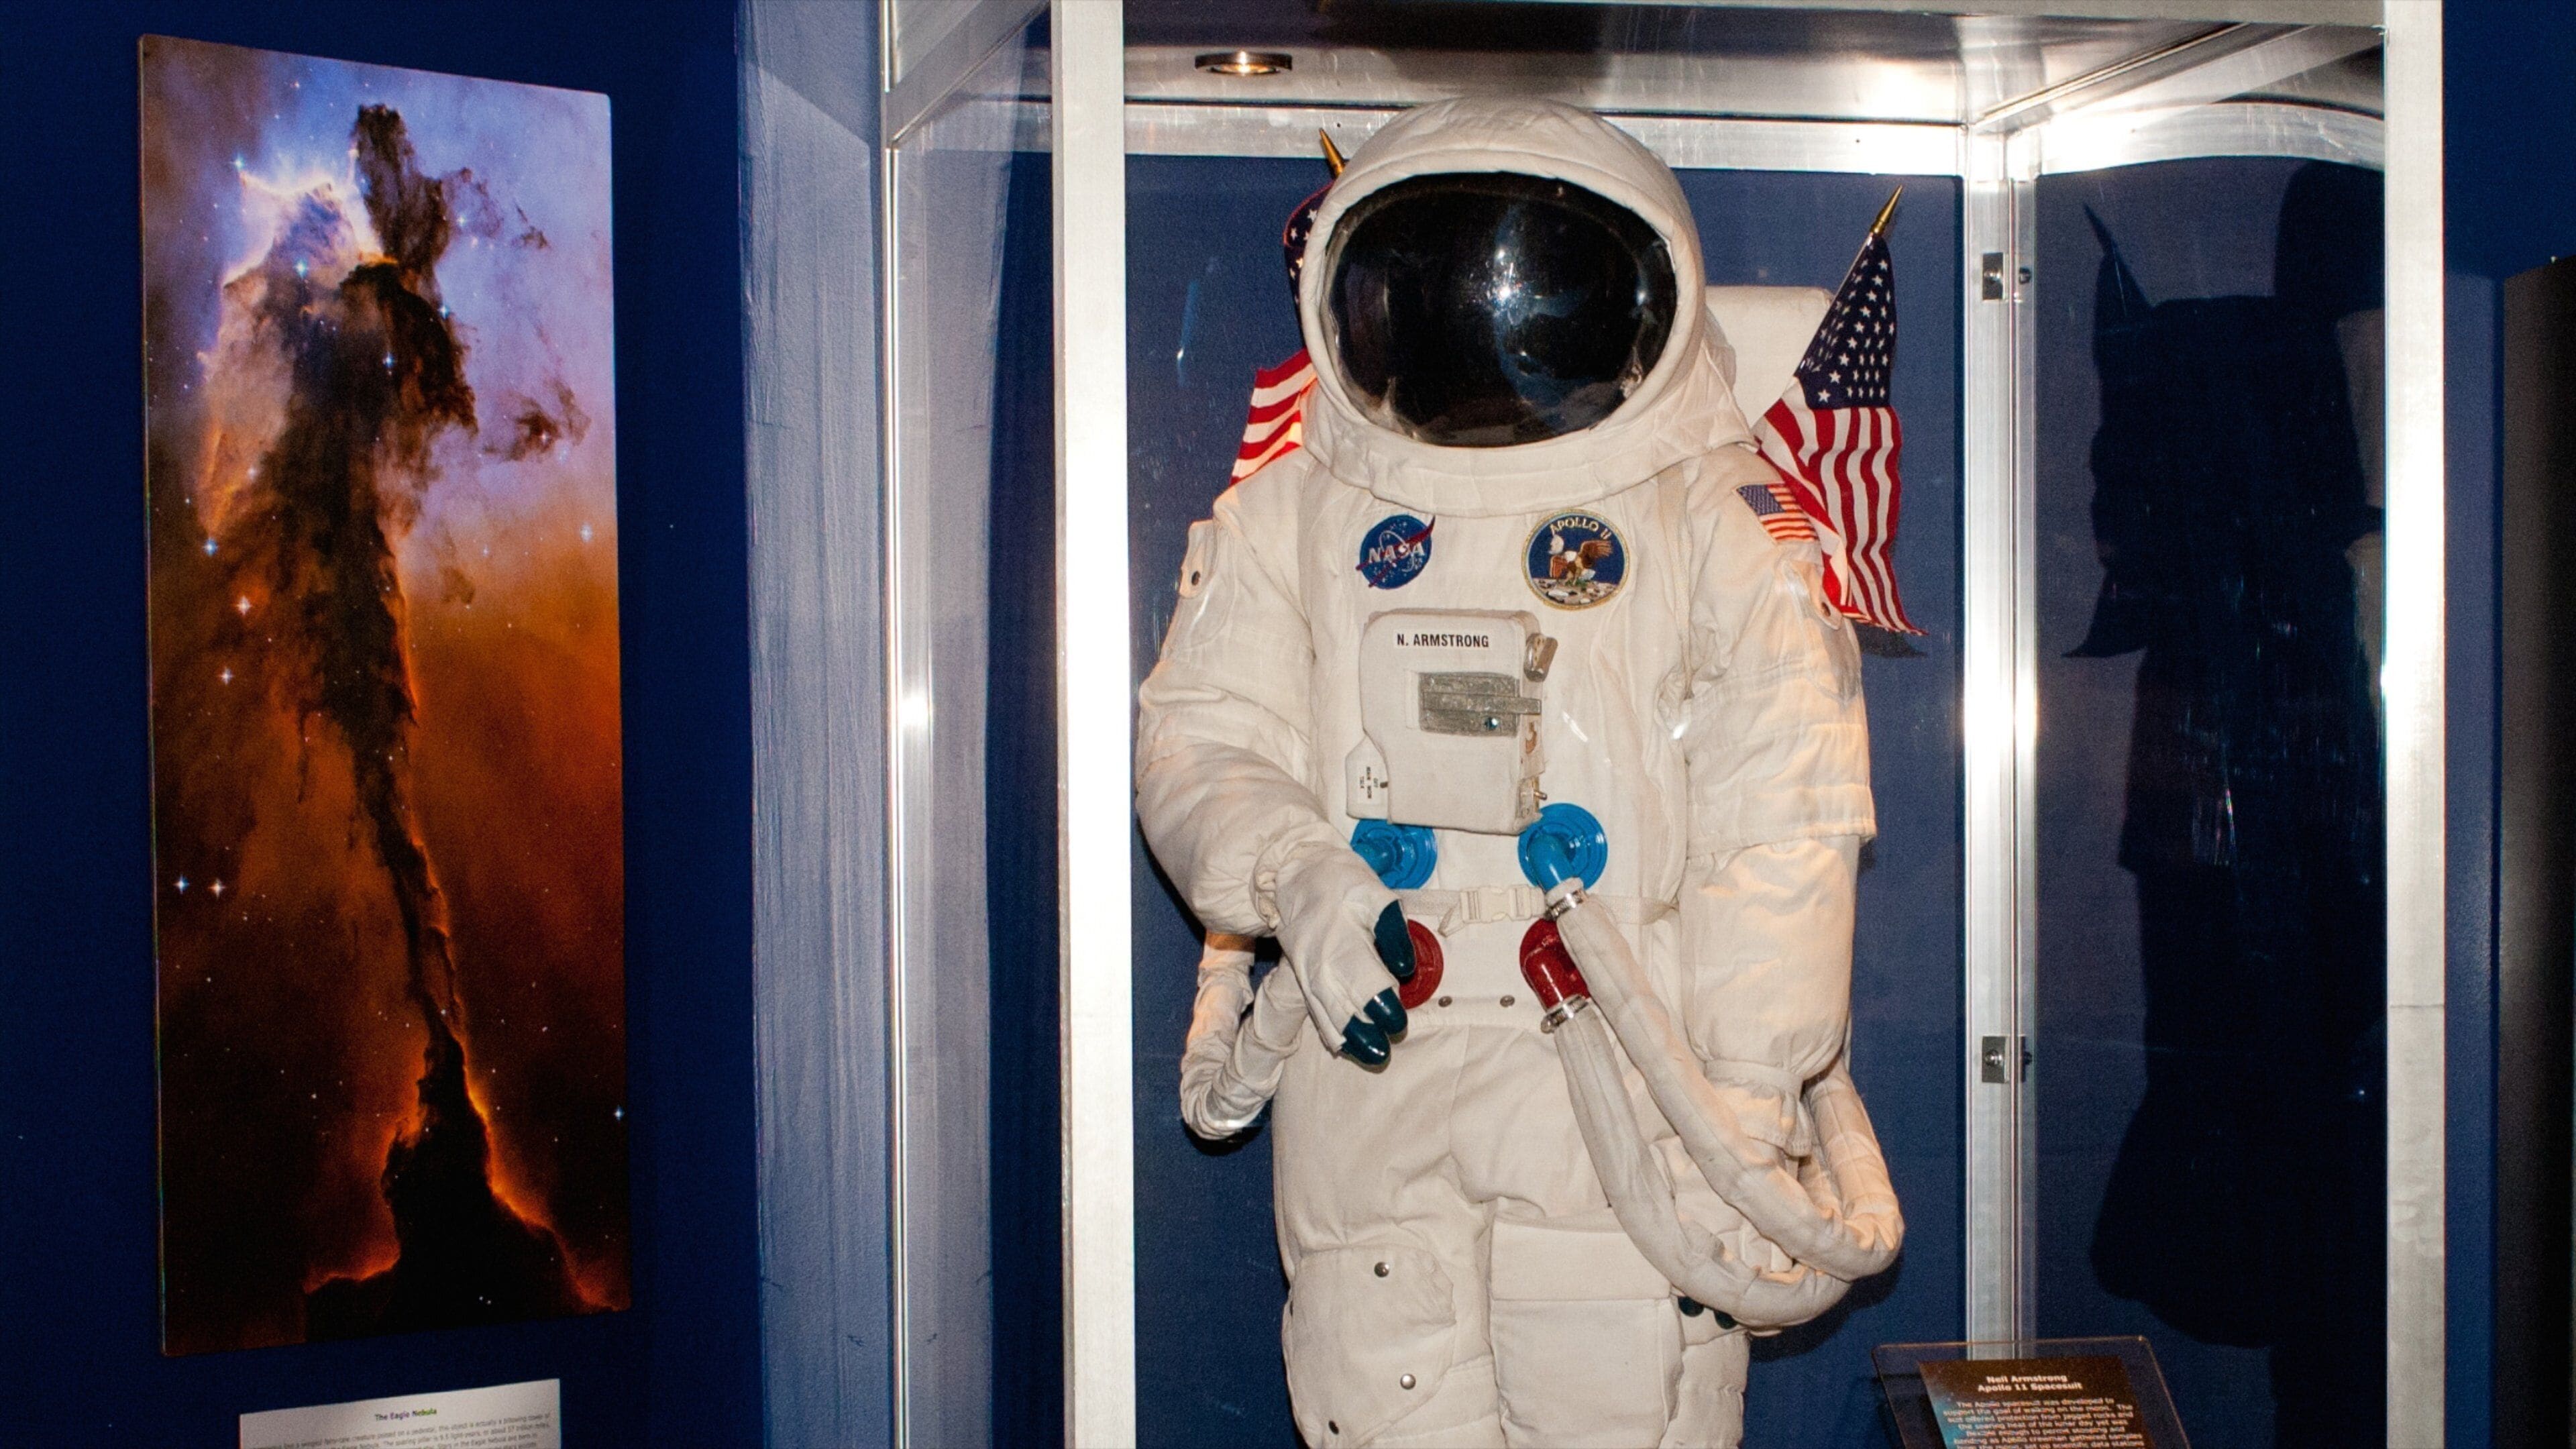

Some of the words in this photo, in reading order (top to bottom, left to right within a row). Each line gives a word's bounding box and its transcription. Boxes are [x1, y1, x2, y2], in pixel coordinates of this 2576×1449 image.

[1550, 517, 1599, 536] APOLLO
[1368, 541, 1425, 564] NASA
[1397, 633, 1409, 646] N.
[1413, 633, 1489, 647] ARMSTRONG
[2011, 1375, 2068, 1383] Armstrong
[1978, 1384, 2012, 1393] Apollo
[2030, 1382, 2083, 1391] Spacesuit
[390, 1411, 410, 1420] Eagle
[413, 1408, 437, 1417] Nebula
